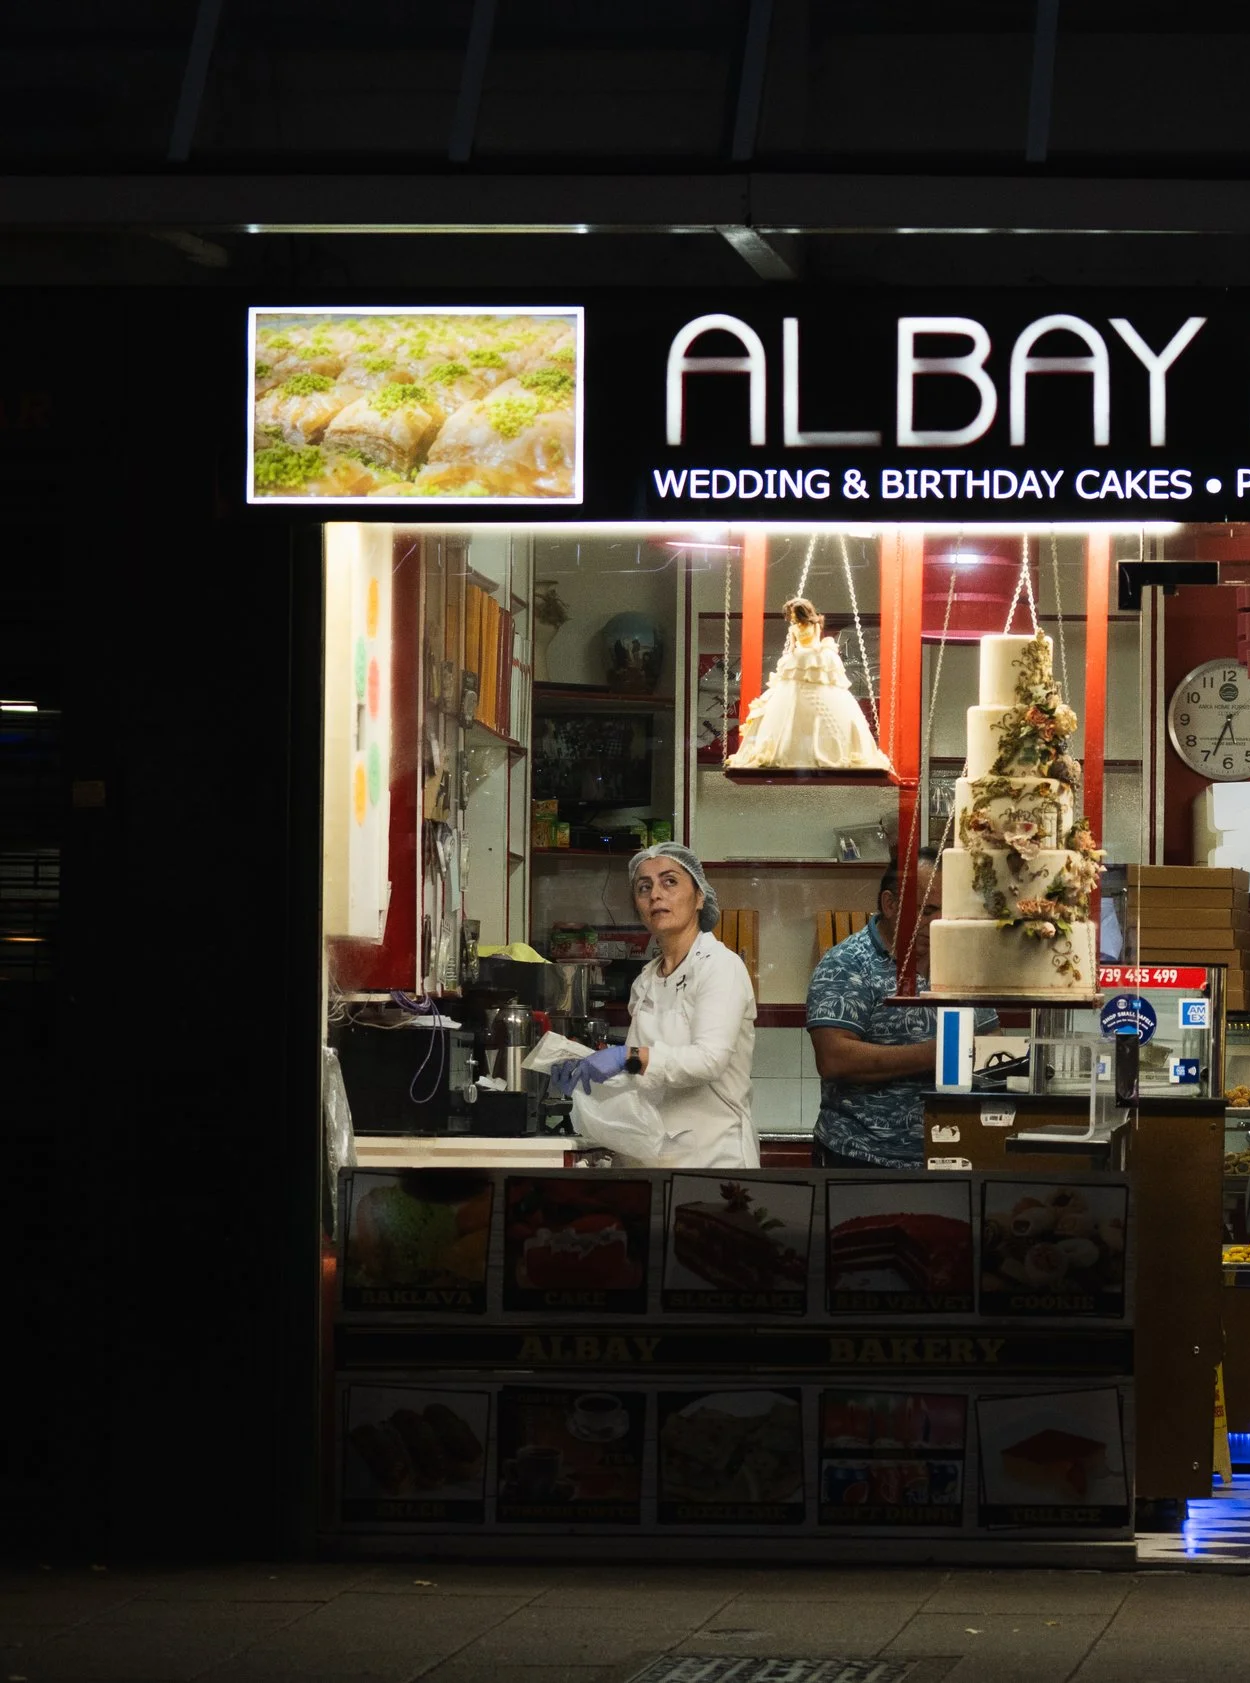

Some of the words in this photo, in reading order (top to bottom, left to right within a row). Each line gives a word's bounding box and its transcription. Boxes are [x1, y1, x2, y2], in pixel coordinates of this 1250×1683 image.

[665, 313, 1207, 448] ALBAY
[652, 467, 831, 500] WEDDING
[841, 467, 871, 500] &
[879, 467, 1065, 500] BIRTHDAY
[1074, 468, 1193, 500] CAKES
[1202, 676, 1214, 688] 11
[1222, 670, 1237, 682] 12
[1187, 691, 1201, 704] 10
[1179, 713, 1191, 726] 9
[1185, 734, 1198, 748] 8
[1200, 750, 1212, 762] 7
[1222, 757, 1234, 770] 6
[1099, 967, 1122, 983] 739
[1125, 968, 1150, 983] 455
[1153, 969, 1178, 984] 499
[1102, 1013, 1117, 1025] SHOP
[361, 1289, 474, 1306] BAKLAVA
[544, 1290, 607, 1306] CAKE
[669, 1292, 732, 1307] SLICE
[740, 1293, 801, 1309] CAKE
[836, 1295, 880, 1310] RED
[886, 1295, 973, 1311] VELVET
[1010, 1294, 1095, 1310] COOKIE
[514, 1335, 662, 1363] ALBAY
[828, 1337, 1006, 1364] BAKERY
